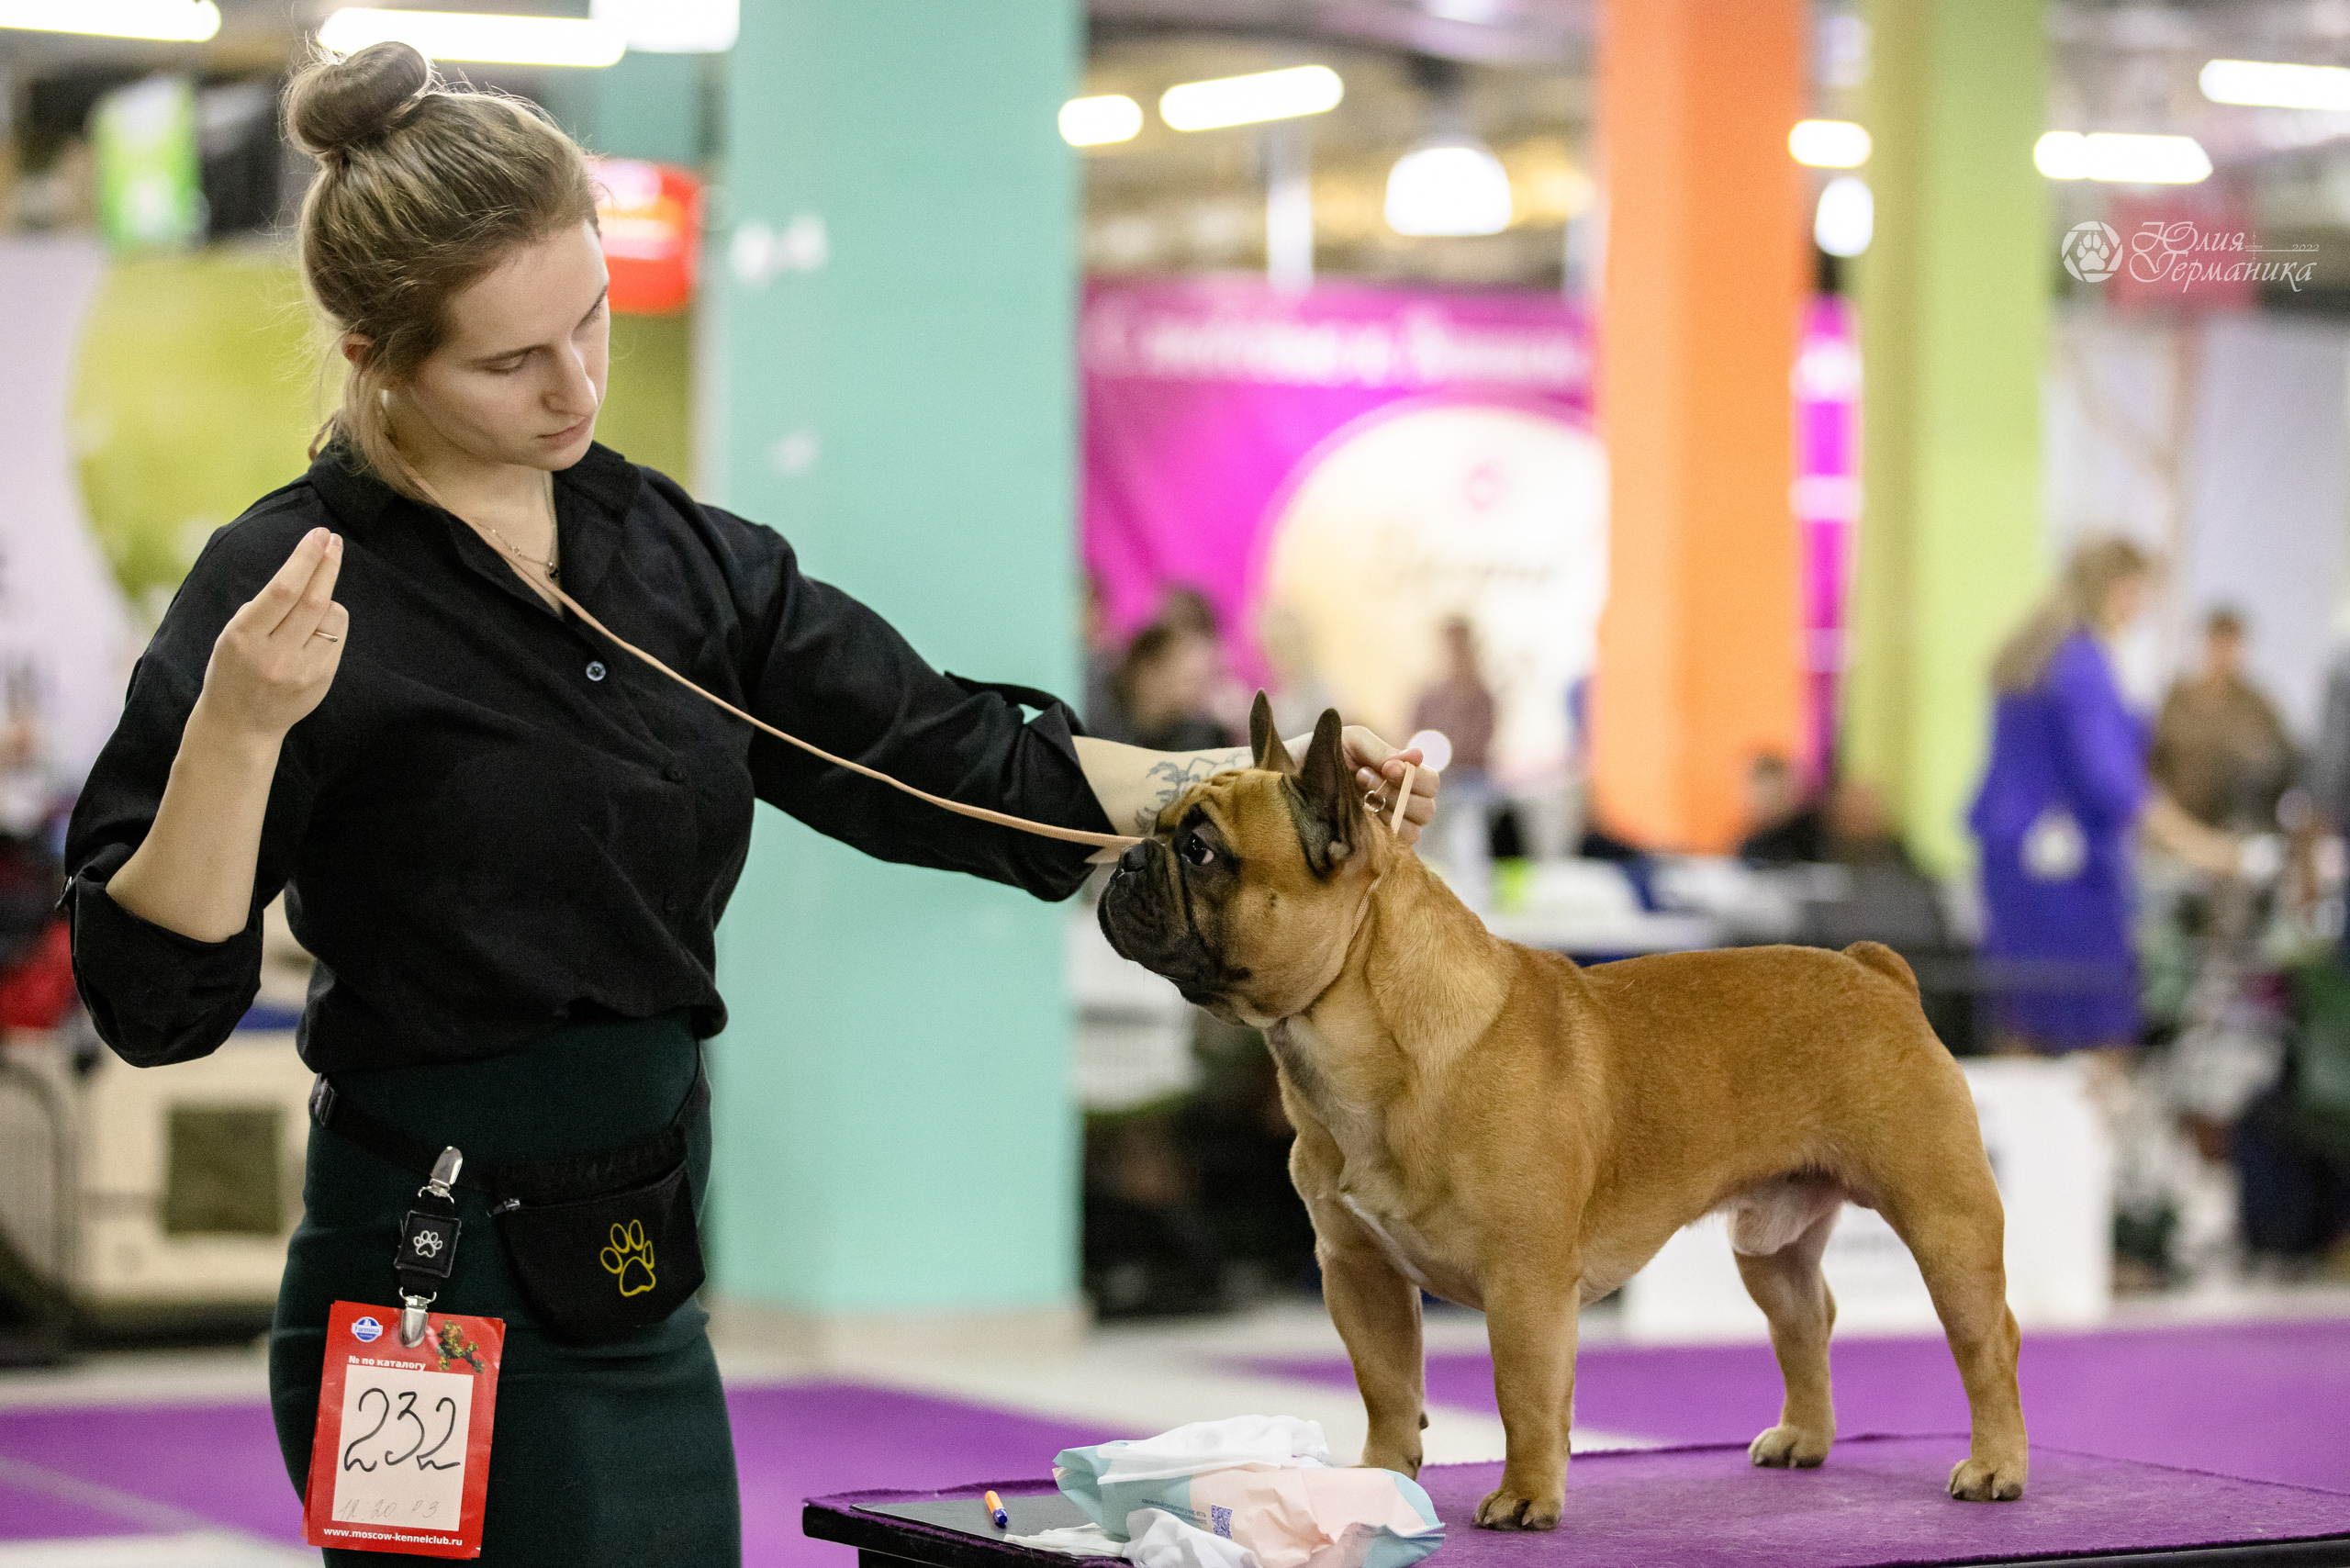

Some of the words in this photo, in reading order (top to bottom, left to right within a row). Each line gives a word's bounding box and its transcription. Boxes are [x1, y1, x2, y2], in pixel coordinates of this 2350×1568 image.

[349, 1355, 360, 1364] №
[362, 1358, 375, 1366] по
[376, 1359, 426, 1371] каталогу
[344, 1387, 461, 1473] 232
[323, 1528, 463, 1546] www.moscow-kennelclub.ru
